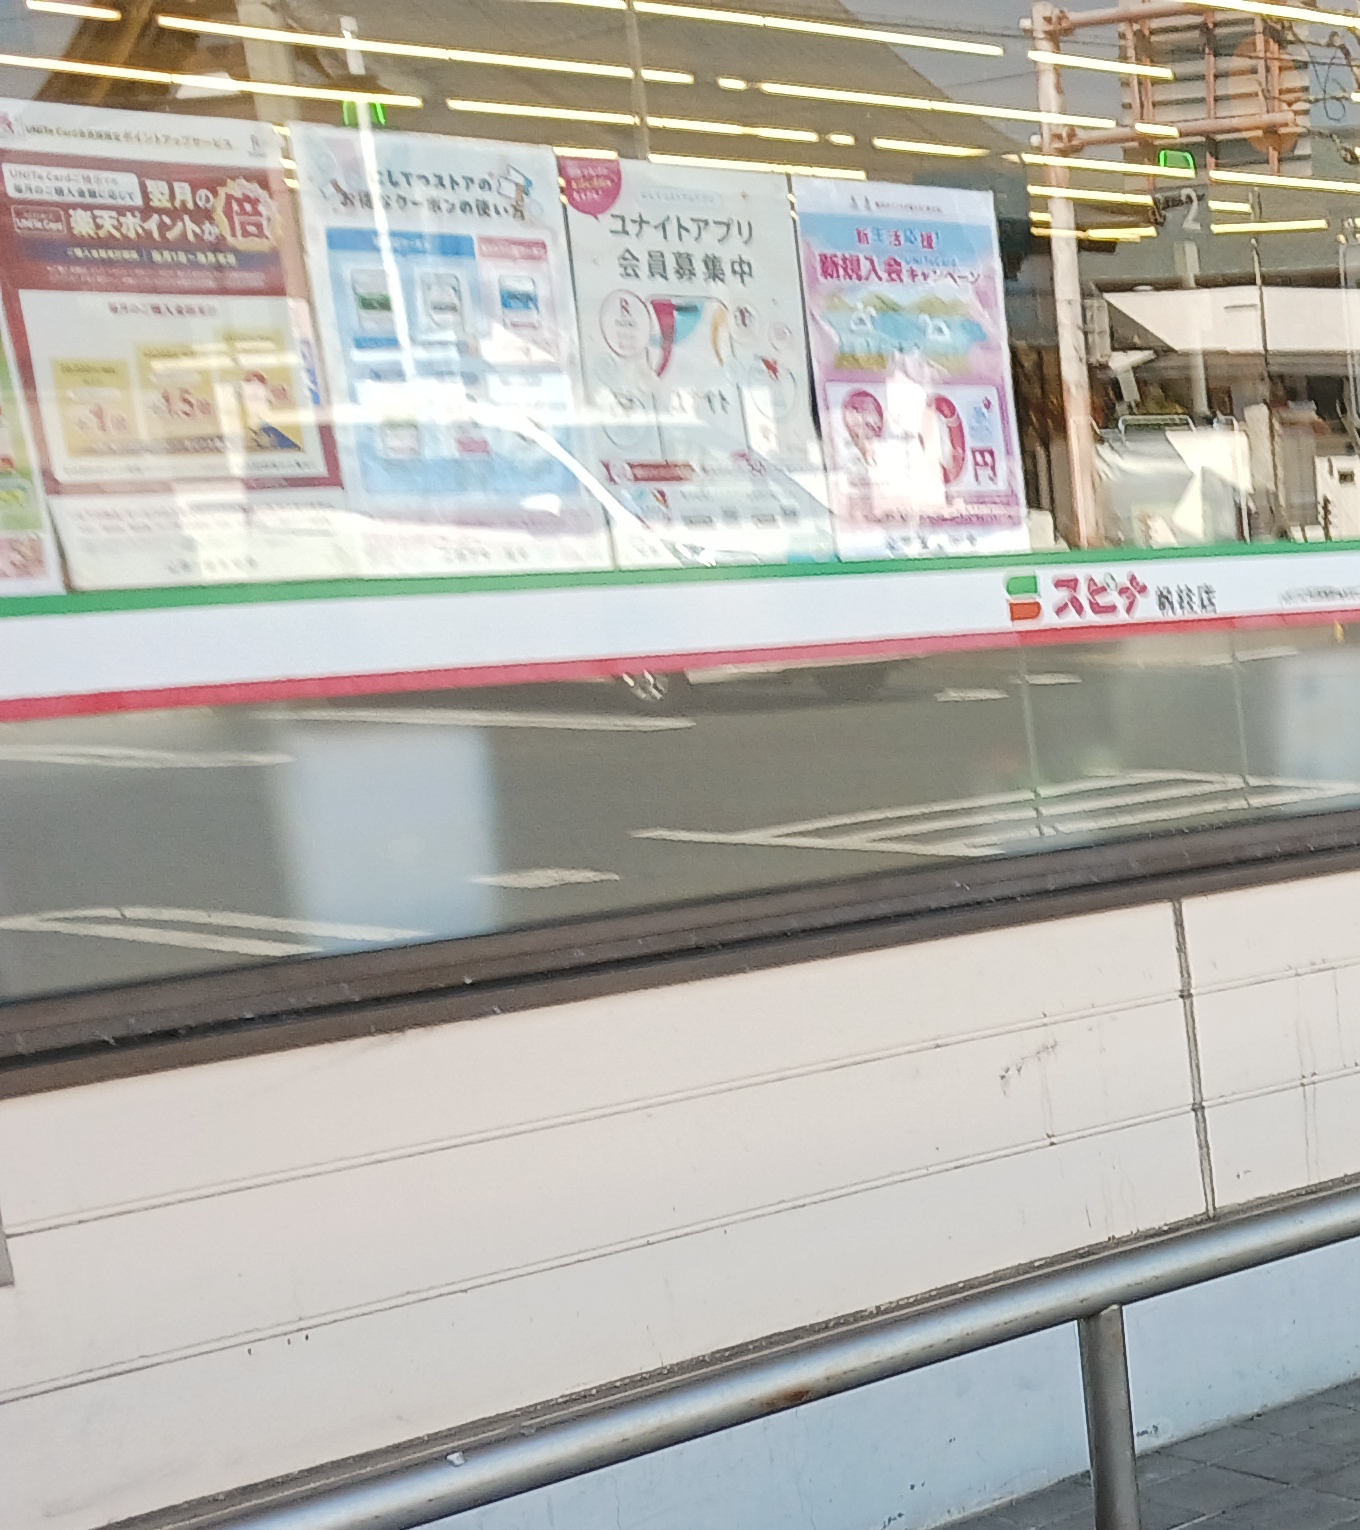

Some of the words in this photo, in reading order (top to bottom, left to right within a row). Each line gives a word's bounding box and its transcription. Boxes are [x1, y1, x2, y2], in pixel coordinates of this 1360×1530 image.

[610, 213, 753, 244] ユナイトアプリ
[617, 248, 753, 286] 会員募集中
[818, 253, 904, 283] 新規入会
[1052, 572, 1149, 618] スピナ
